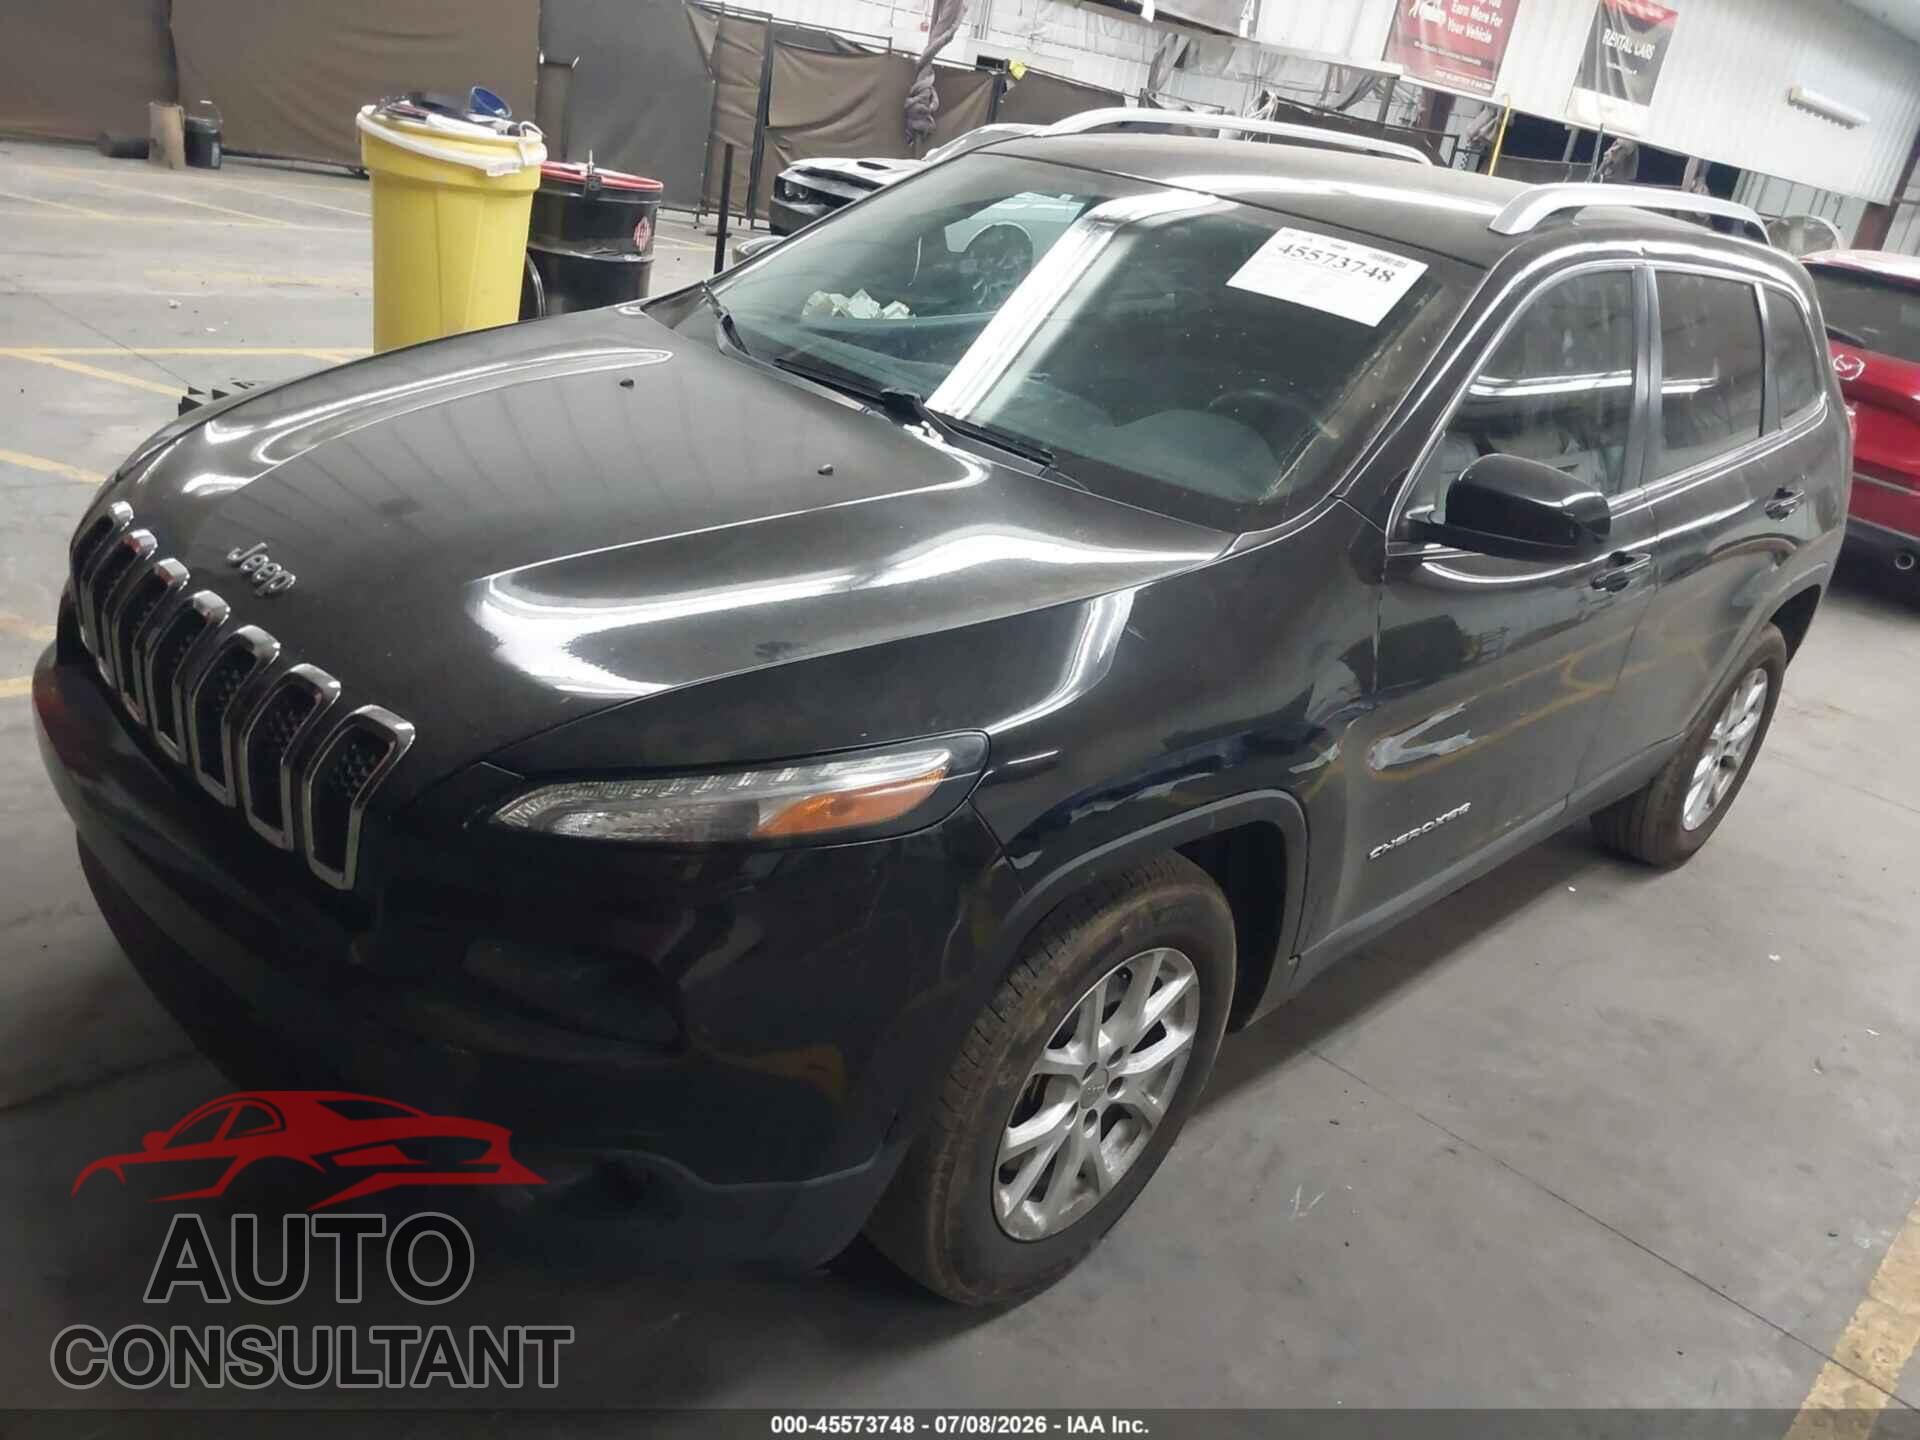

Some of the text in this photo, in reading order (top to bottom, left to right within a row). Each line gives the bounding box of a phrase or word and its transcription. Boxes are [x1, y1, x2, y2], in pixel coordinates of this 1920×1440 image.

[1471, 5, 1490, 22] More
[1490, 12, 1503, 27] For
[1447, 17, 1492, 43] Your Vehicle
[1602, 28, 1633, 54] RENTAL
[1278, 244, 1396, 283] 45573748
[227, 542, 296, 596] Jeep
